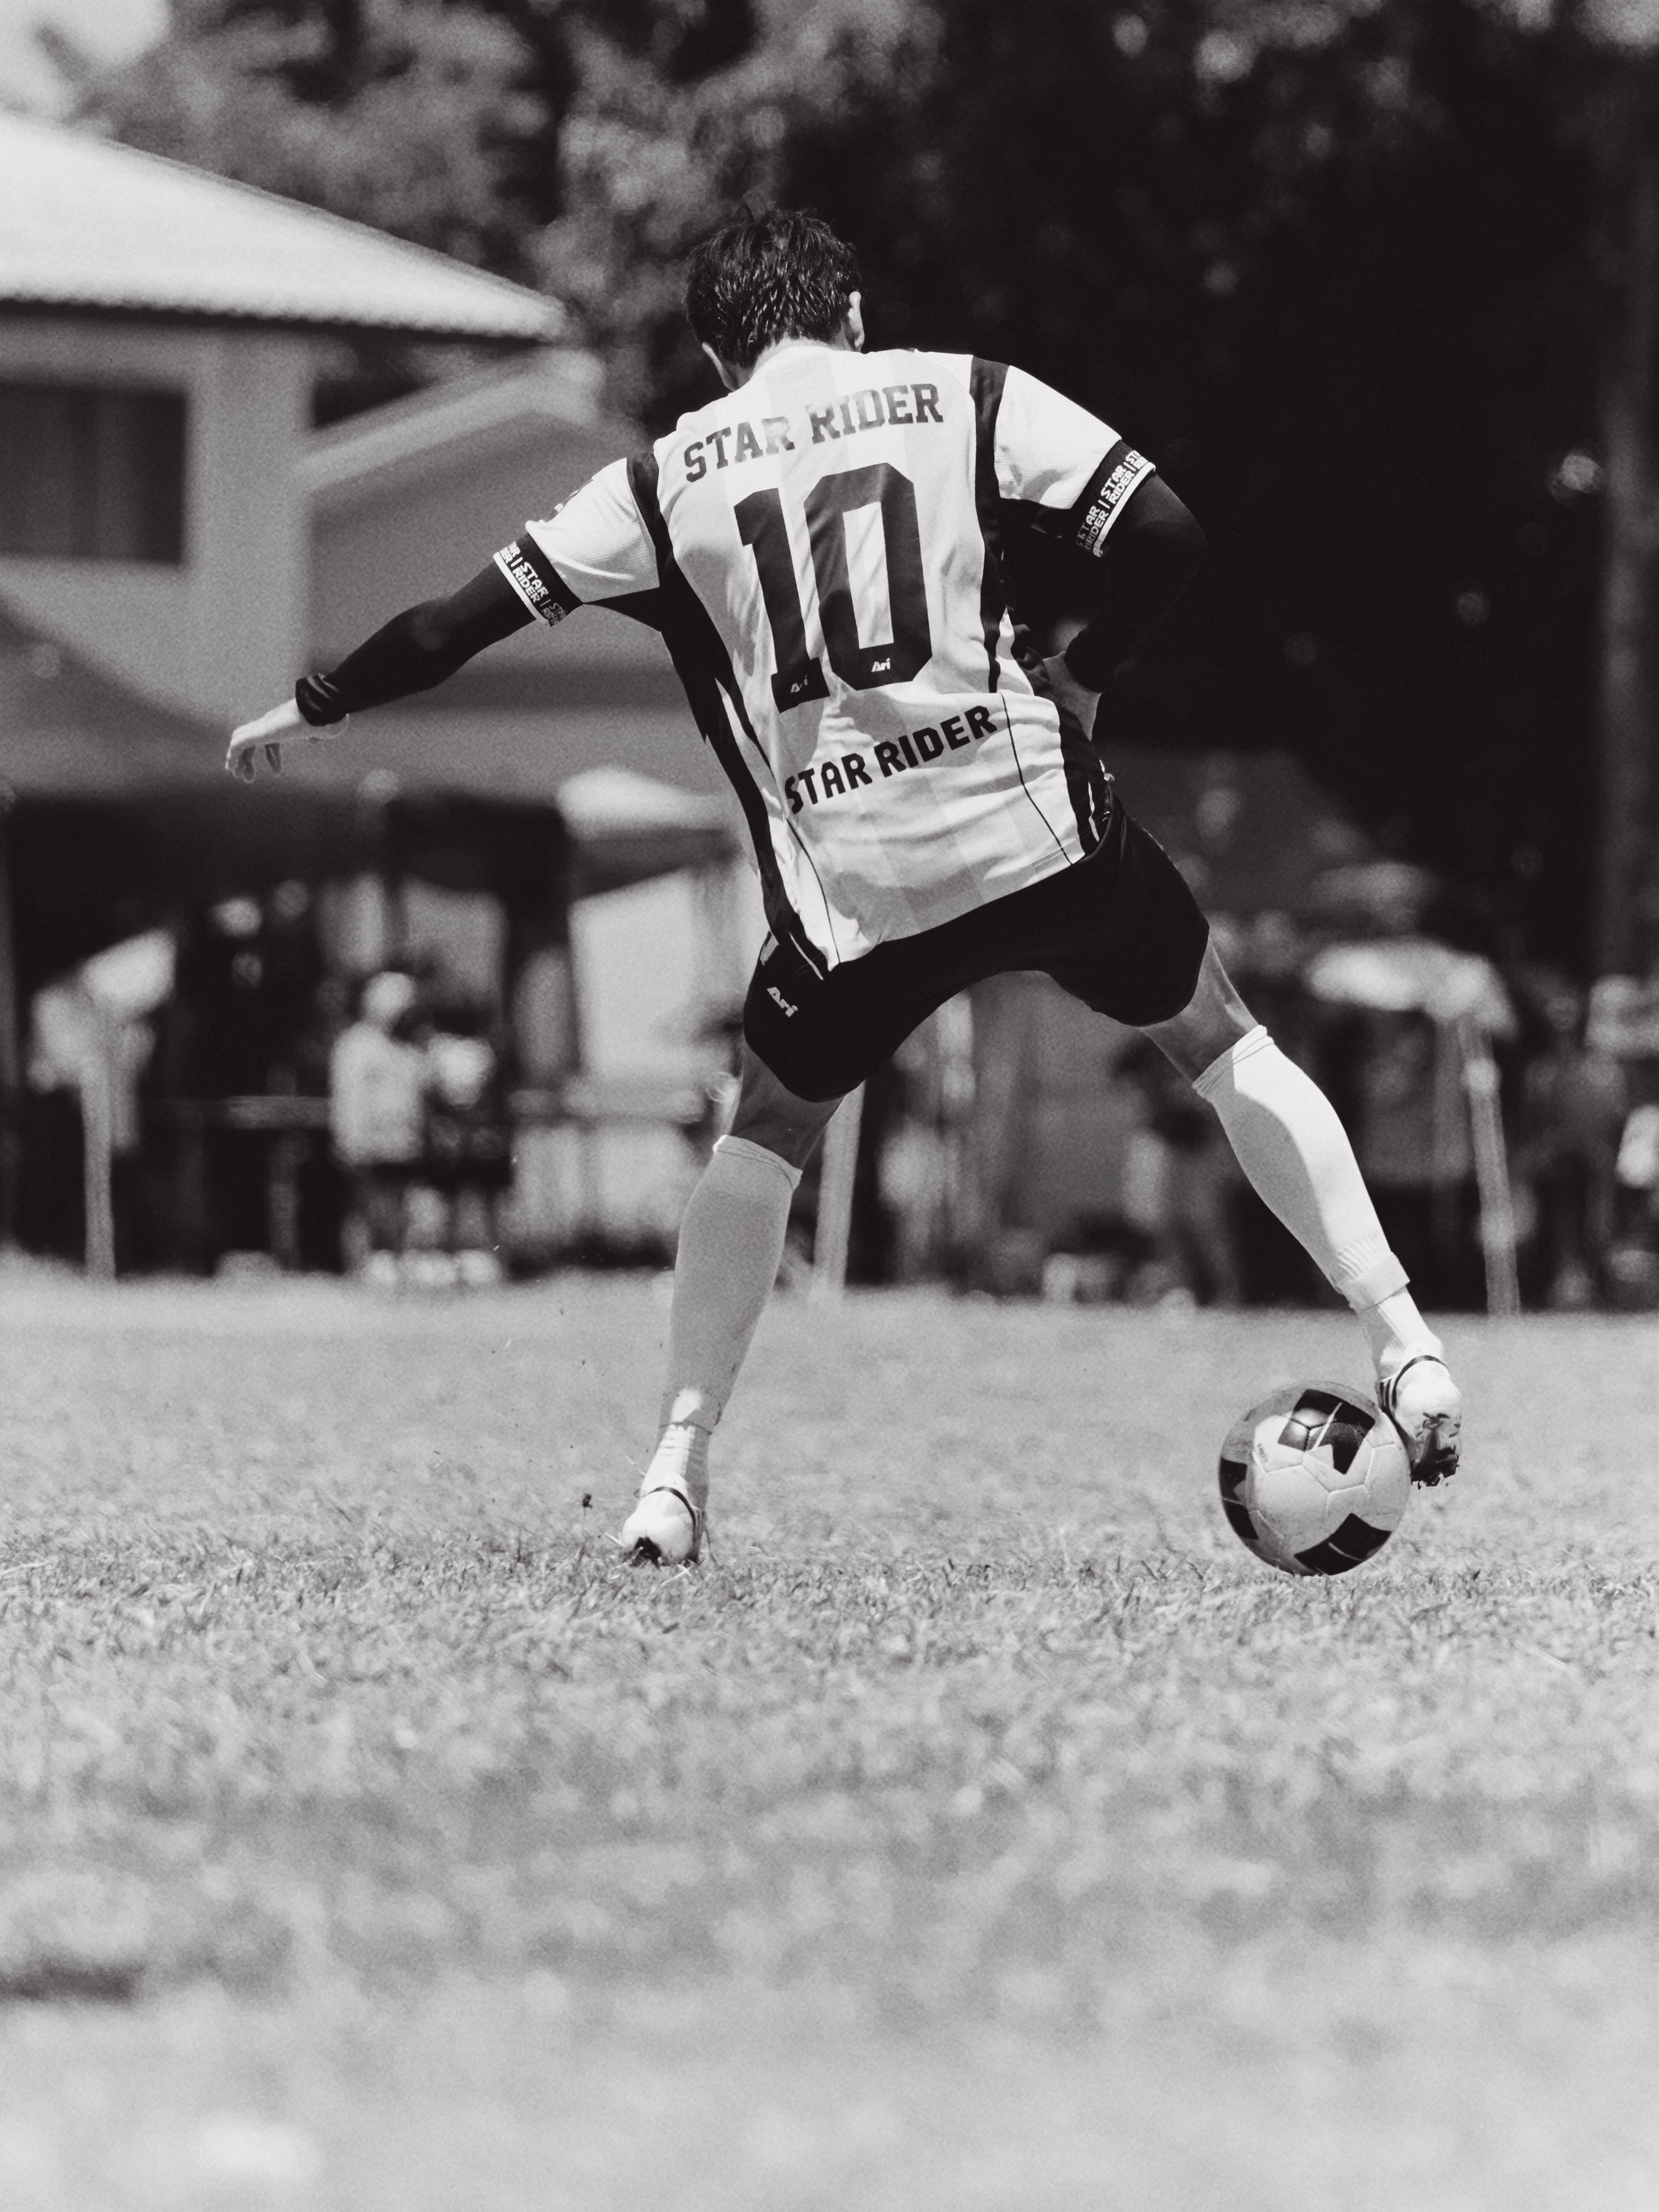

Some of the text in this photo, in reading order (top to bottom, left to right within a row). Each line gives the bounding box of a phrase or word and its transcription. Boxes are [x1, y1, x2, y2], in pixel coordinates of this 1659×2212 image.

[683, 383, 944, 482] STAR RIDER
[1100, 465, 1126, 500] STAR
[1108, 470, 1136, 505] RIDER
[512, 566, 541, 603] RIDER
[520, 561, 548, 598] STAR
[734, 462, 933, 713] 10
[871, 658, 891, 673] Ari
[784, 705, 998, 815] STAR RIDER
[766, 987, 799, 1018] Ari
